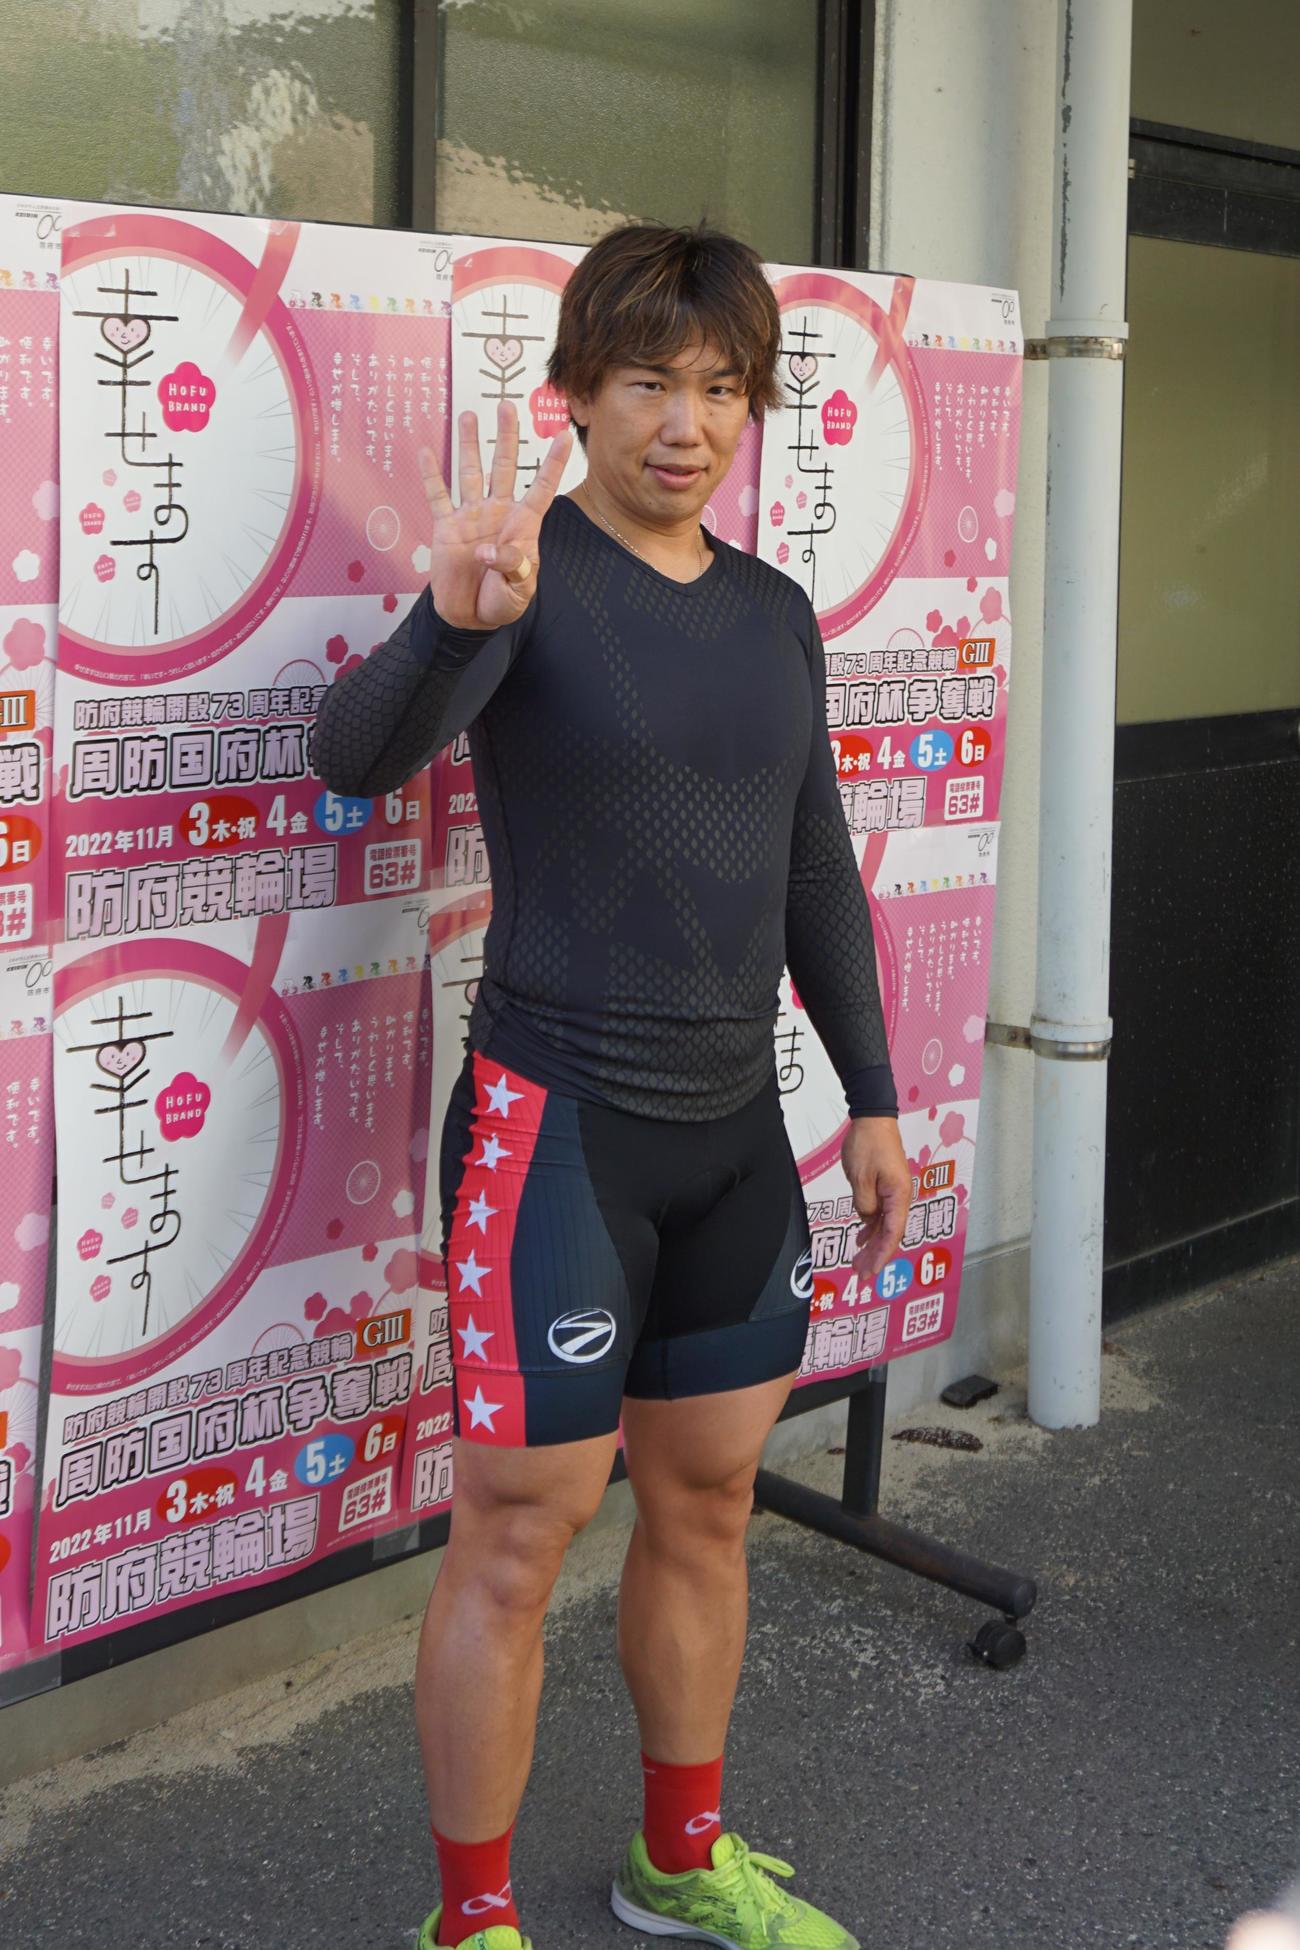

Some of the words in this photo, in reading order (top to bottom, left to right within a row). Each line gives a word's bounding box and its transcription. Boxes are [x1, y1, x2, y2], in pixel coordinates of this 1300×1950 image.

[168, 383, 207, 397] HOFU
[168, 401, 207, 413] BRAND
[827, 406, 851, 418] HOFU
[826, 420, 851, 431] BRAND
[70, 724, 319, 798] 周防国府杯
[877, 736, 906, 769] 4金
[918, 734, 947, 768] 5土
[961, 730, 985, 764] 6日
[948, 793, 980, 815] 63#
[65, 825, 173, 857] 2022年11月
[266, 795, 308, 836] 4金
[325, 790, 363, 832] 5土
[385, 787, 420, 824] 6日
[369, 860, 416, 889] 63#
[66, 844, 337, 941] 防府競輪場
[165, 1092, 203, 1109] HOFU
[165, 1109, 203, 1125] BRAND
[842, 1274, 872, 1306] 4金
[882, 1264, 908, 1298] 5土
[920, 1252, 946, 1285] 6日
[906, 1310, 939, 1336] 63#
[56, 1352, 412, 1508] 周防国府杯争奪戦
[49, 1508, 151, 1564] 2022年11月
[245, 1457, 288, 1498] 4金
[306, 1441, 345, 1484] 5土
[364, 1424, 397, 1463] 6日
[47, 1495, 319, 1641] 防府競輪場
